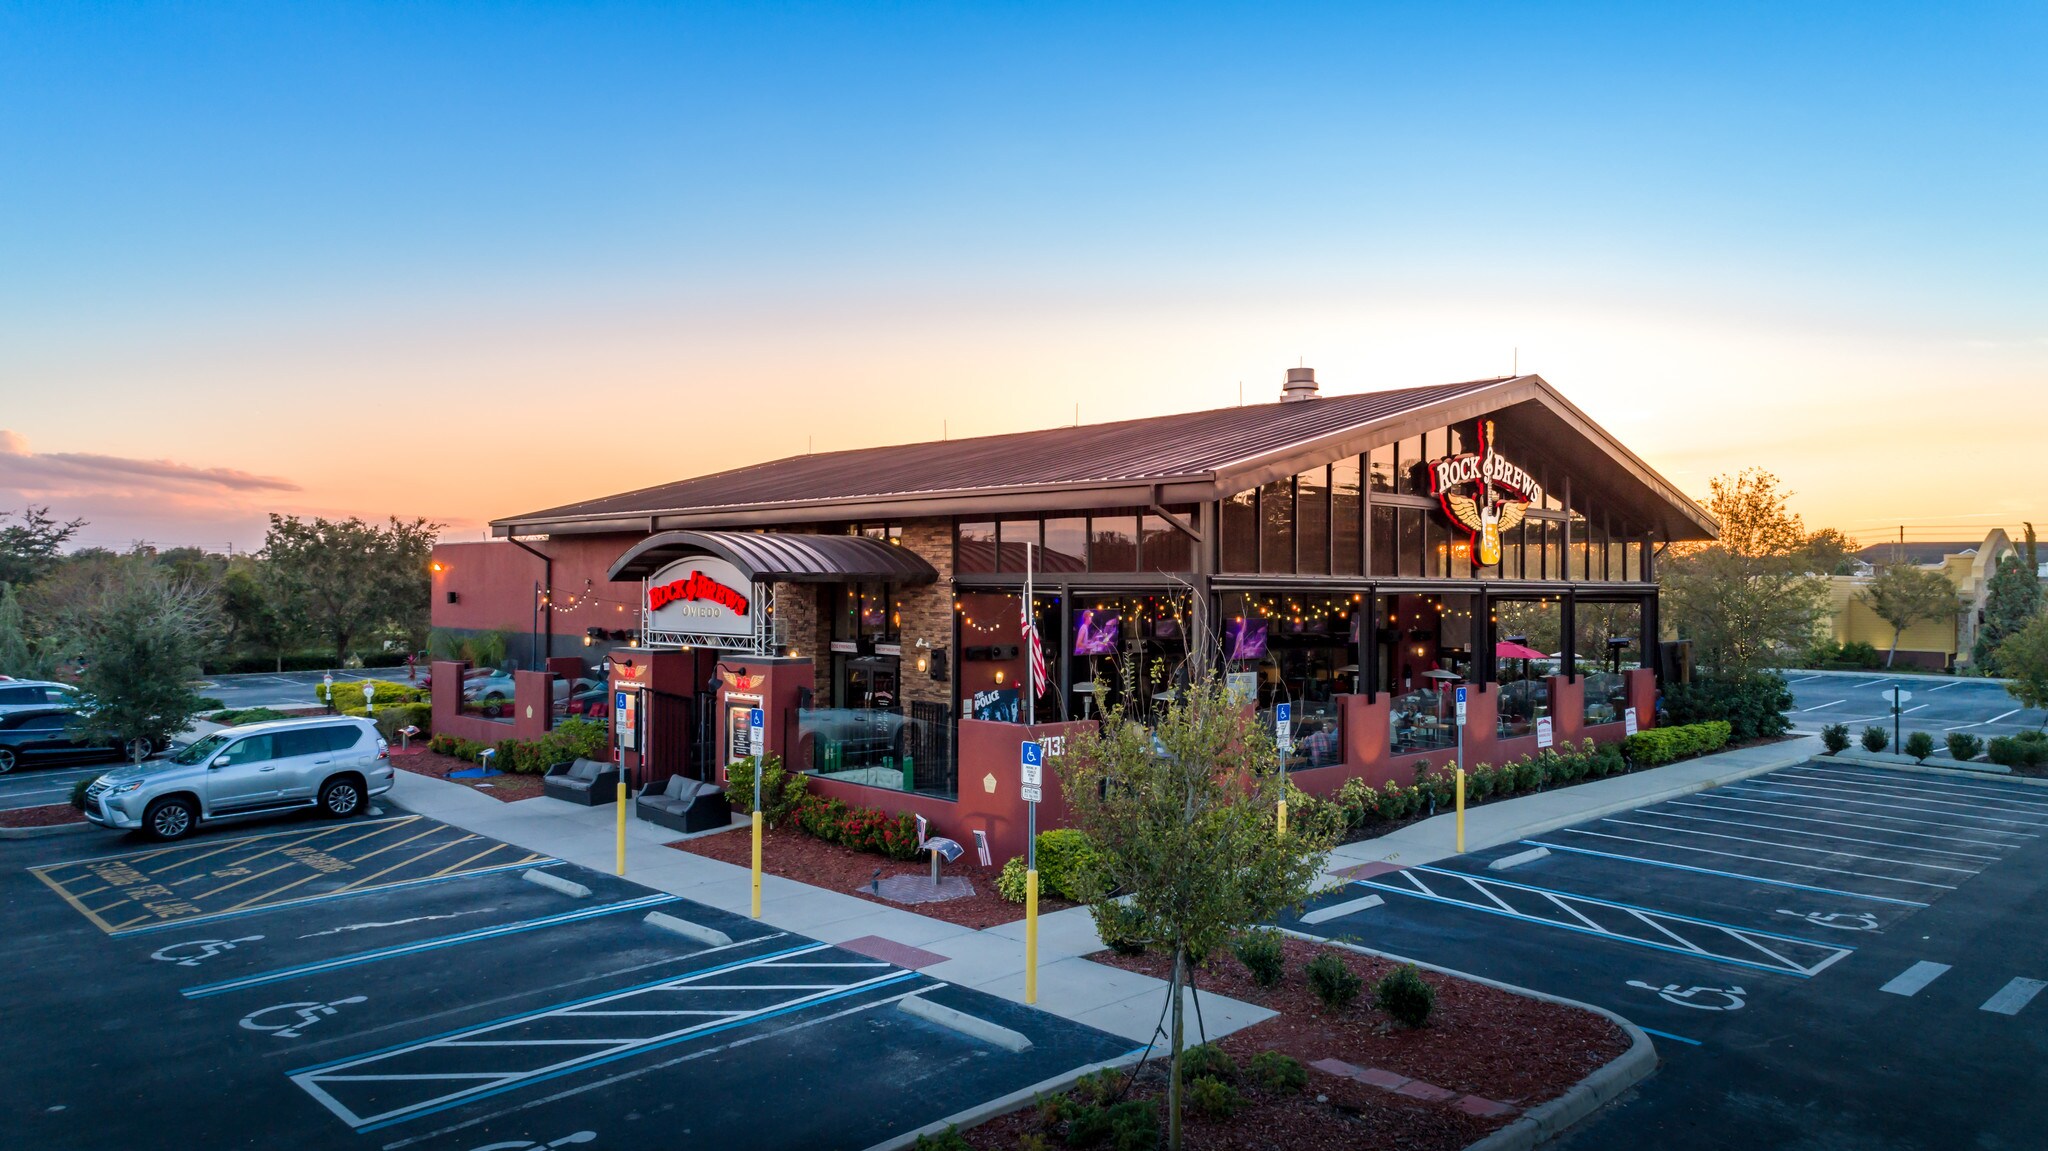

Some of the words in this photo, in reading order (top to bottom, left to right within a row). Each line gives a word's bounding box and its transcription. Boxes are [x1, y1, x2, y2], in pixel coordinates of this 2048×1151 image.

[1437, 456, 1482, 494] ROCK
[1492, 454, 1541, 503] BREWS
[649, 579, 687, 611] ROCK
[695, 575, 748, 616] BREWS
[682, 604, 721, 618] OVIEDO
[974, 691, 985, 700] THE
[974, 690, 1000, 710] POLICE
